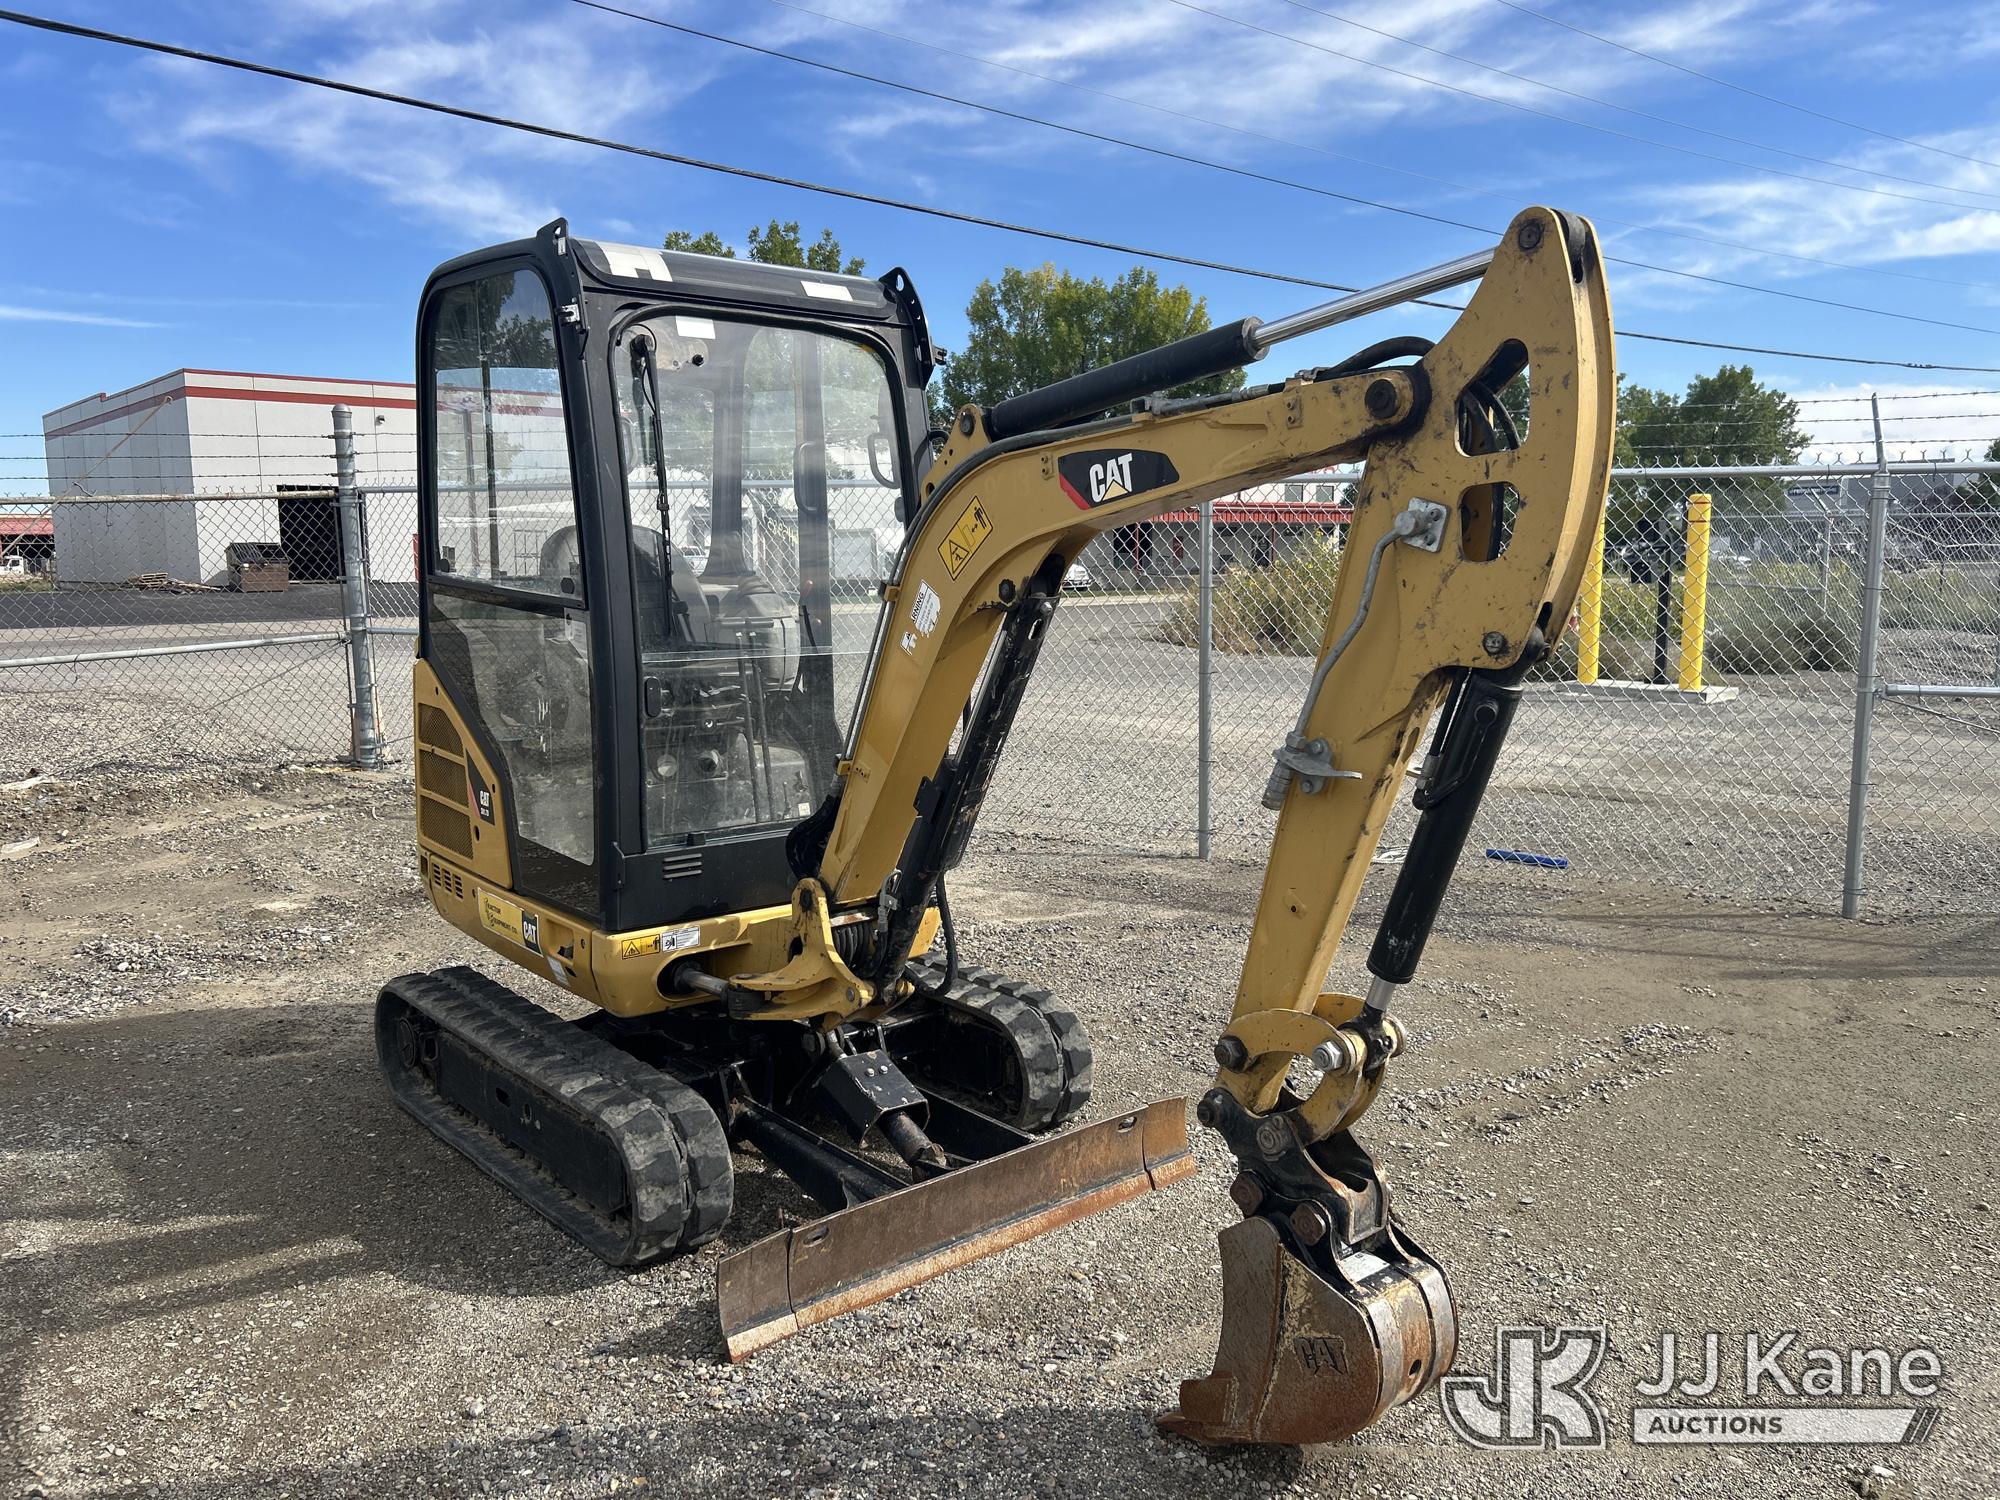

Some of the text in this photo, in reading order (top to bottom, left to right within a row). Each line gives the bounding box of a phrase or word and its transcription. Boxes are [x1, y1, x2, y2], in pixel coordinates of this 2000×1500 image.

[1089, 453, 1133, 503] CAT
[911, 592, 924, 622] RNING
[480, 790, 490, 807] CAT
[523, 920, 537, 944] CAT
[1294, 1336, 1349, 1376] CAT
